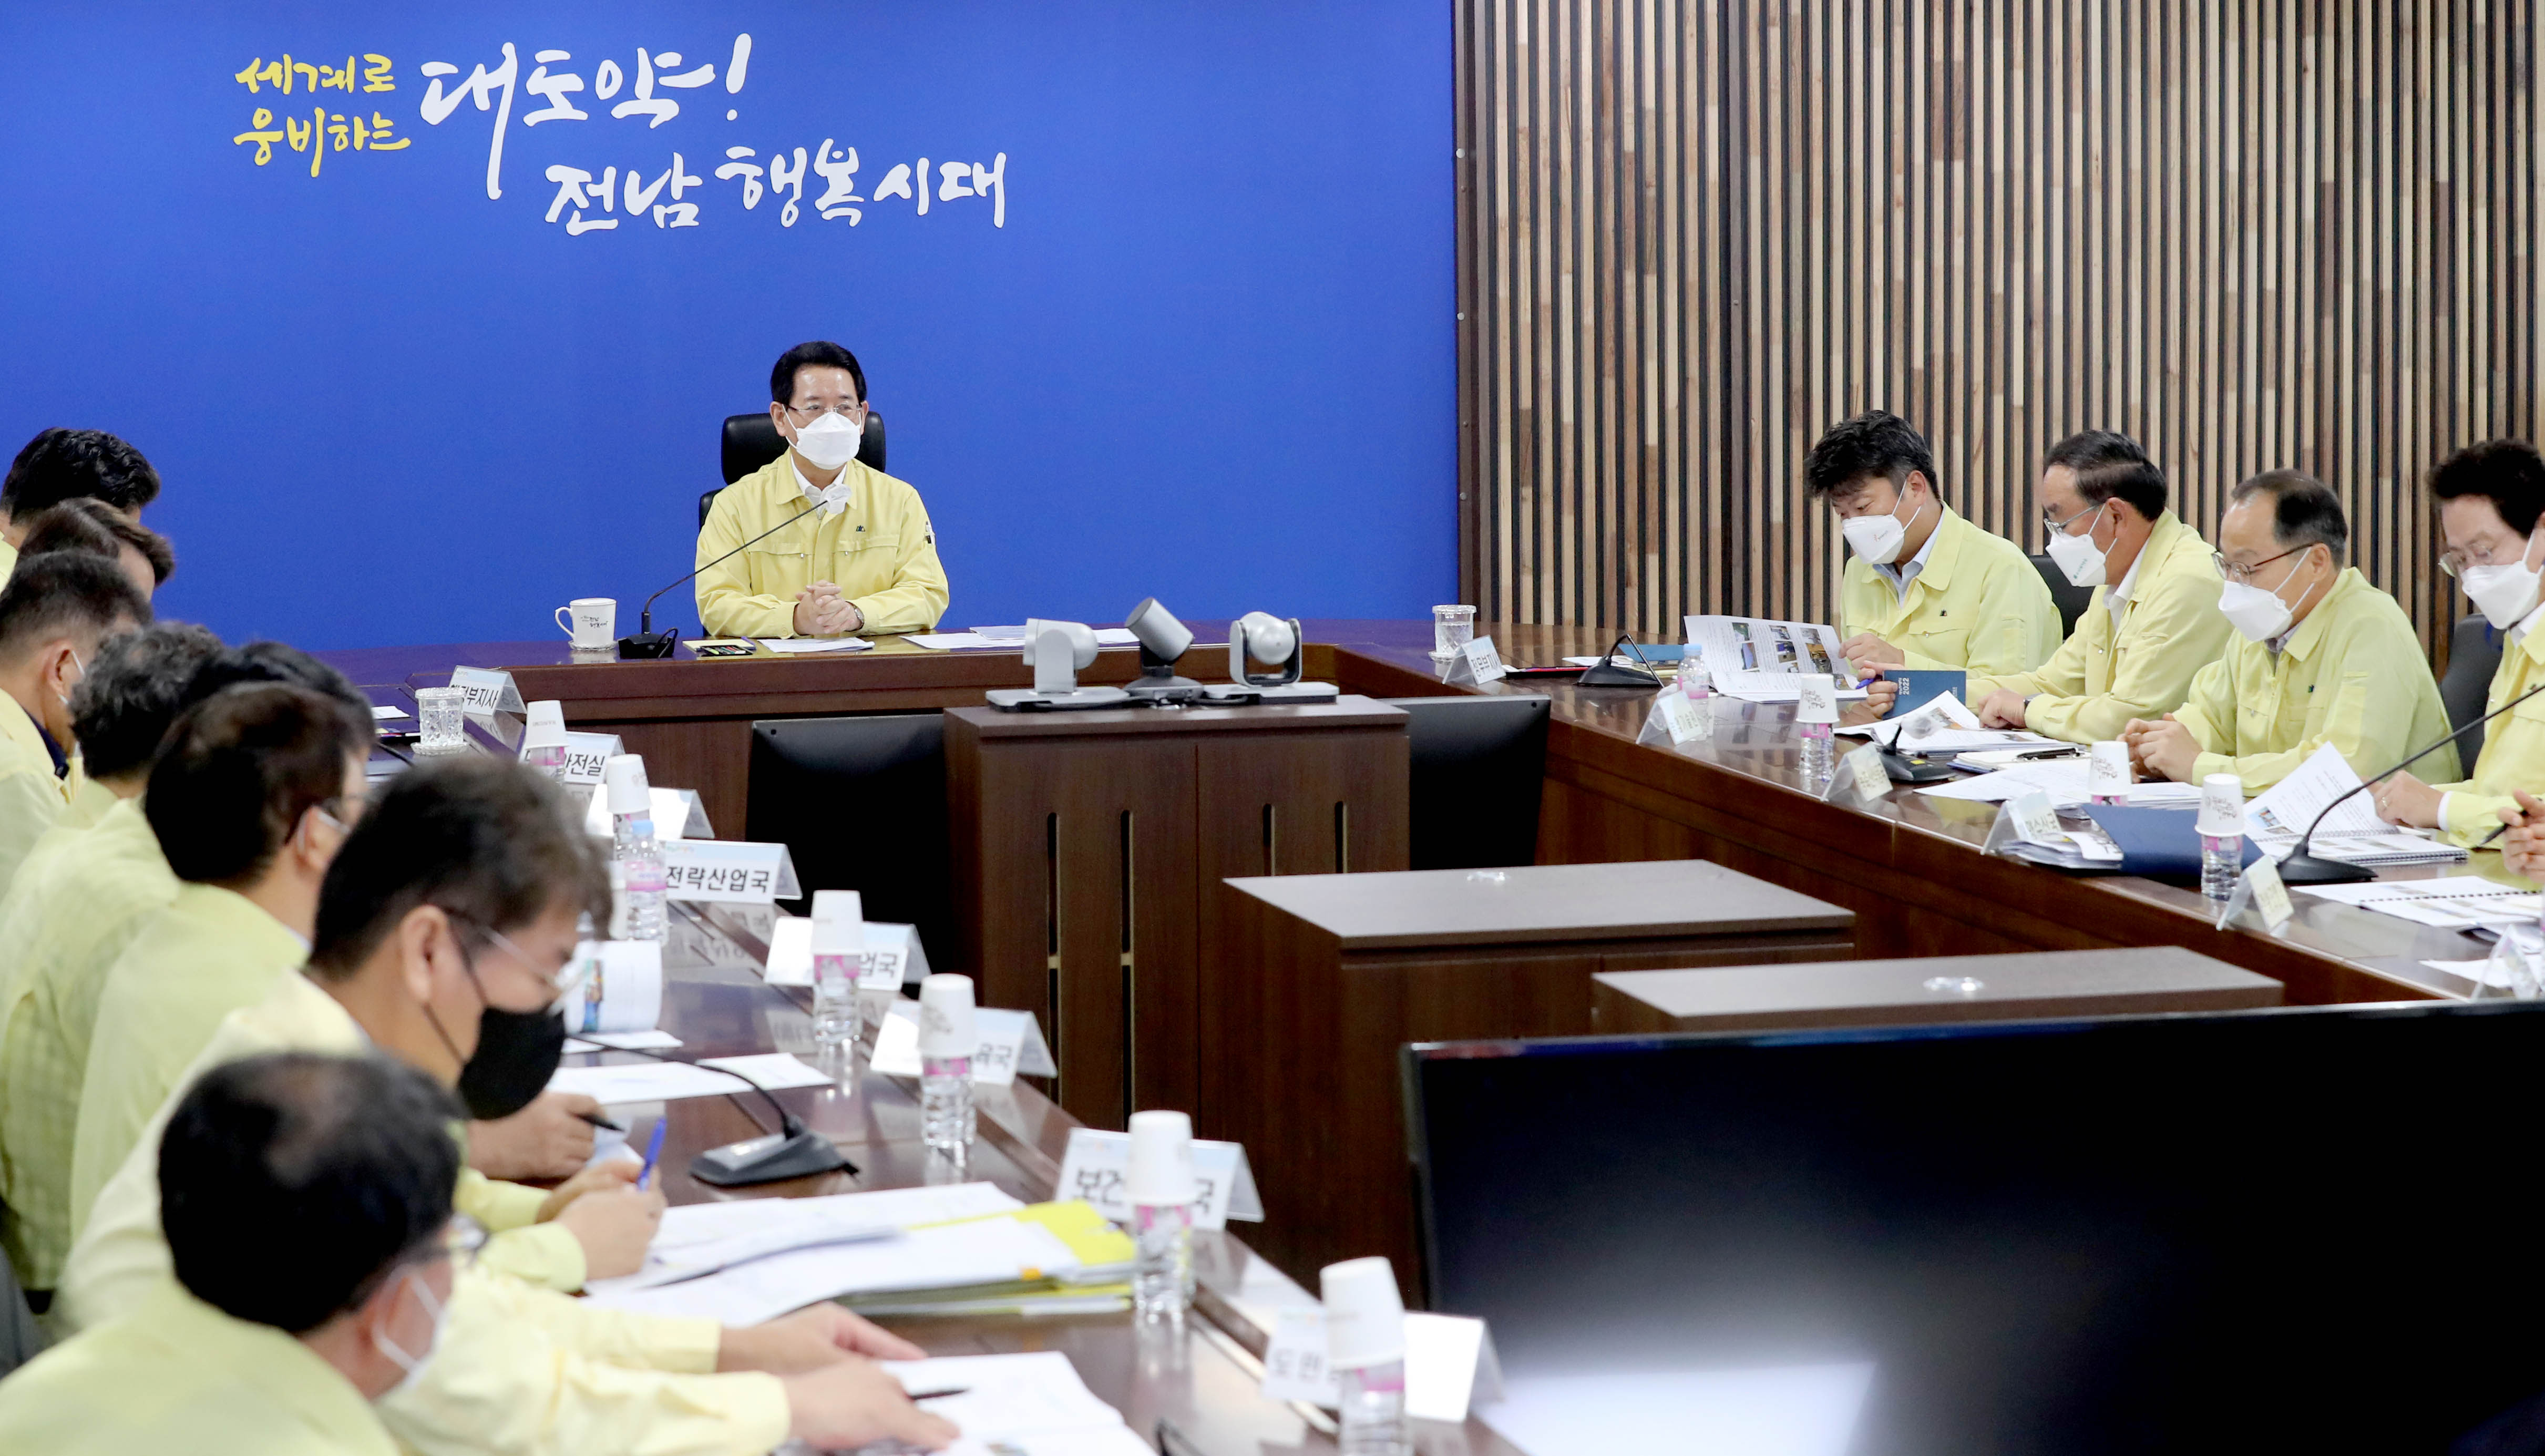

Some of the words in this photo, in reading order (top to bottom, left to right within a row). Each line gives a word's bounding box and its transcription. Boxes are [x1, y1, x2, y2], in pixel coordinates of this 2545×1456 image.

[235, 53, 396, 95] 세계로
[233, 107, 411, 178] 웅비하는
[420, 33, 752, 200] 대도약!
[545, 152, 703, 236] 전남
[666, 866, 770, 894] 전략산업국
[1075, 1167, 1215, 1214] 보건국
